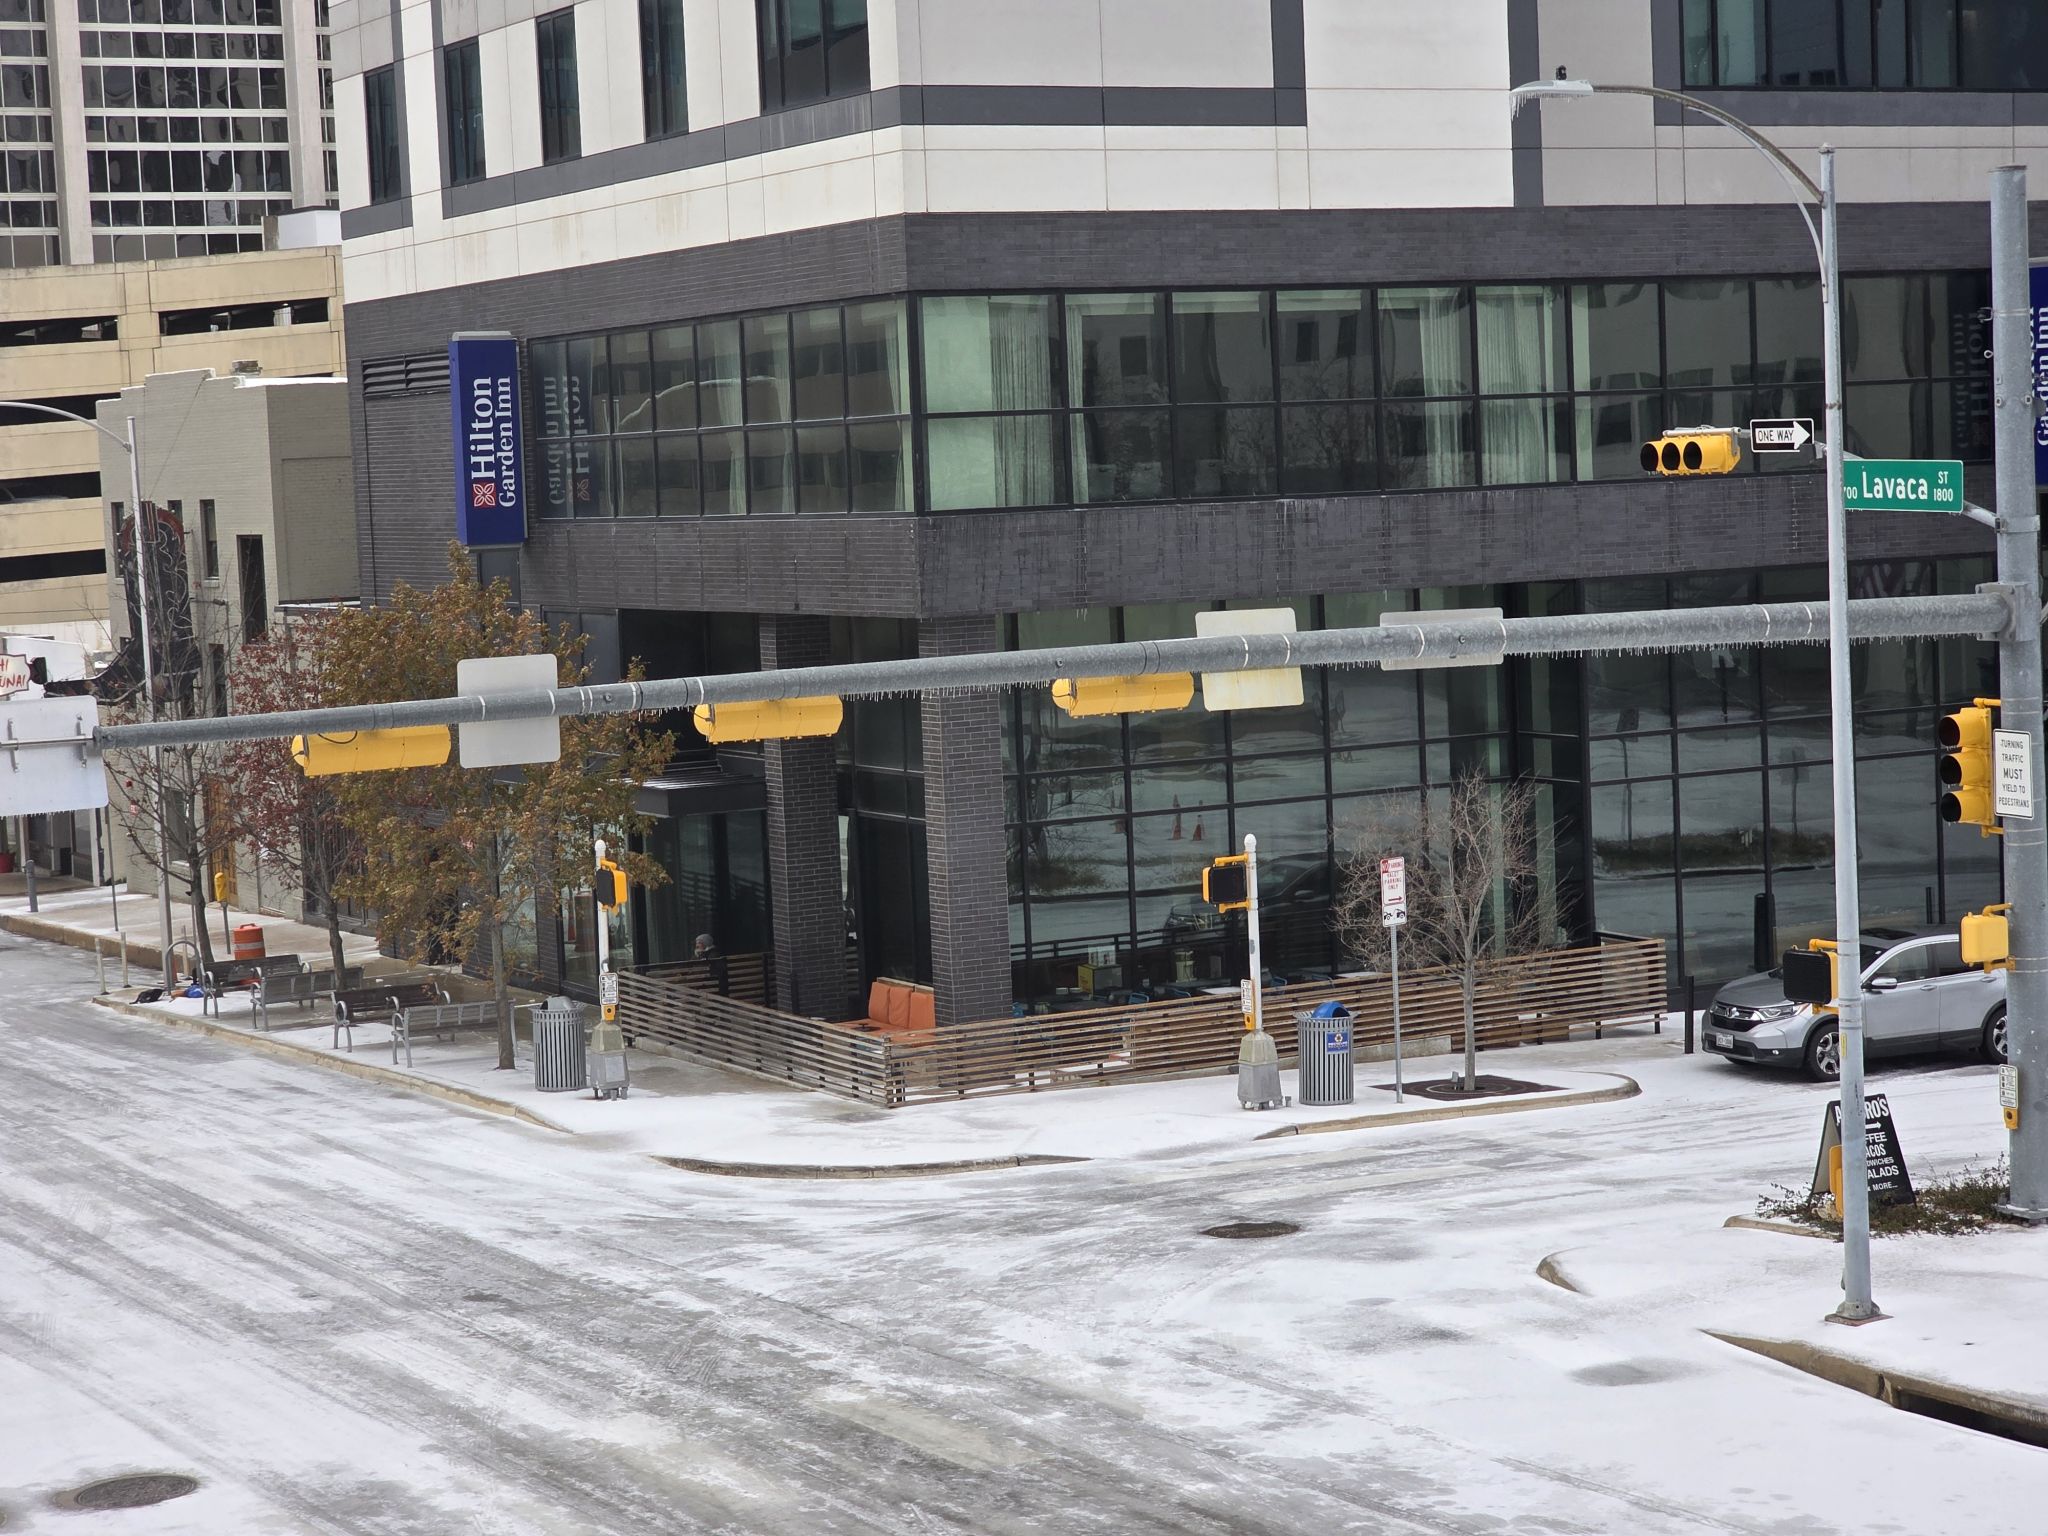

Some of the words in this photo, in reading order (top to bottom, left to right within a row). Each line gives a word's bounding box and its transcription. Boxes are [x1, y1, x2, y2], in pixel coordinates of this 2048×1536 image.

[495, 376, 512, 418] Inn
[2037, 356, 2048, 445] Gaden
[469, 376, 495, 479] Hilton
[1758, 430, 1774, 441] ONE
[1777, 429, 1794, 441] WAY
[497, 421, 516, 507] Garden
[1938, 471, 1949, 484] ST
[1844, 486, 1858, 499] 00
[1862, 471, 1928, 499] Lavaca
[1934, 488, 1954, 502] 1800
[0, 673, 26, 688] UNAI
[2001, 739, 2023, 749] TURNING
[2002, 753, 2023, 763] TRAFFIC
[2003, 768, 2023, 780] MUST
[2002, 783, 2017, 793] YIELD
[2019, 785, 2025, 794] TO
[1999, 797, 2029, 808] PEDESTRIANS
[1834, 1097, 1889, 1126] ARO'S
[1865, 1143, 1886, 1158] ACOS
[1866, 1156, 1895, 1167] DWICHES
[1867, 1165, 1899, 1179] ALADS
